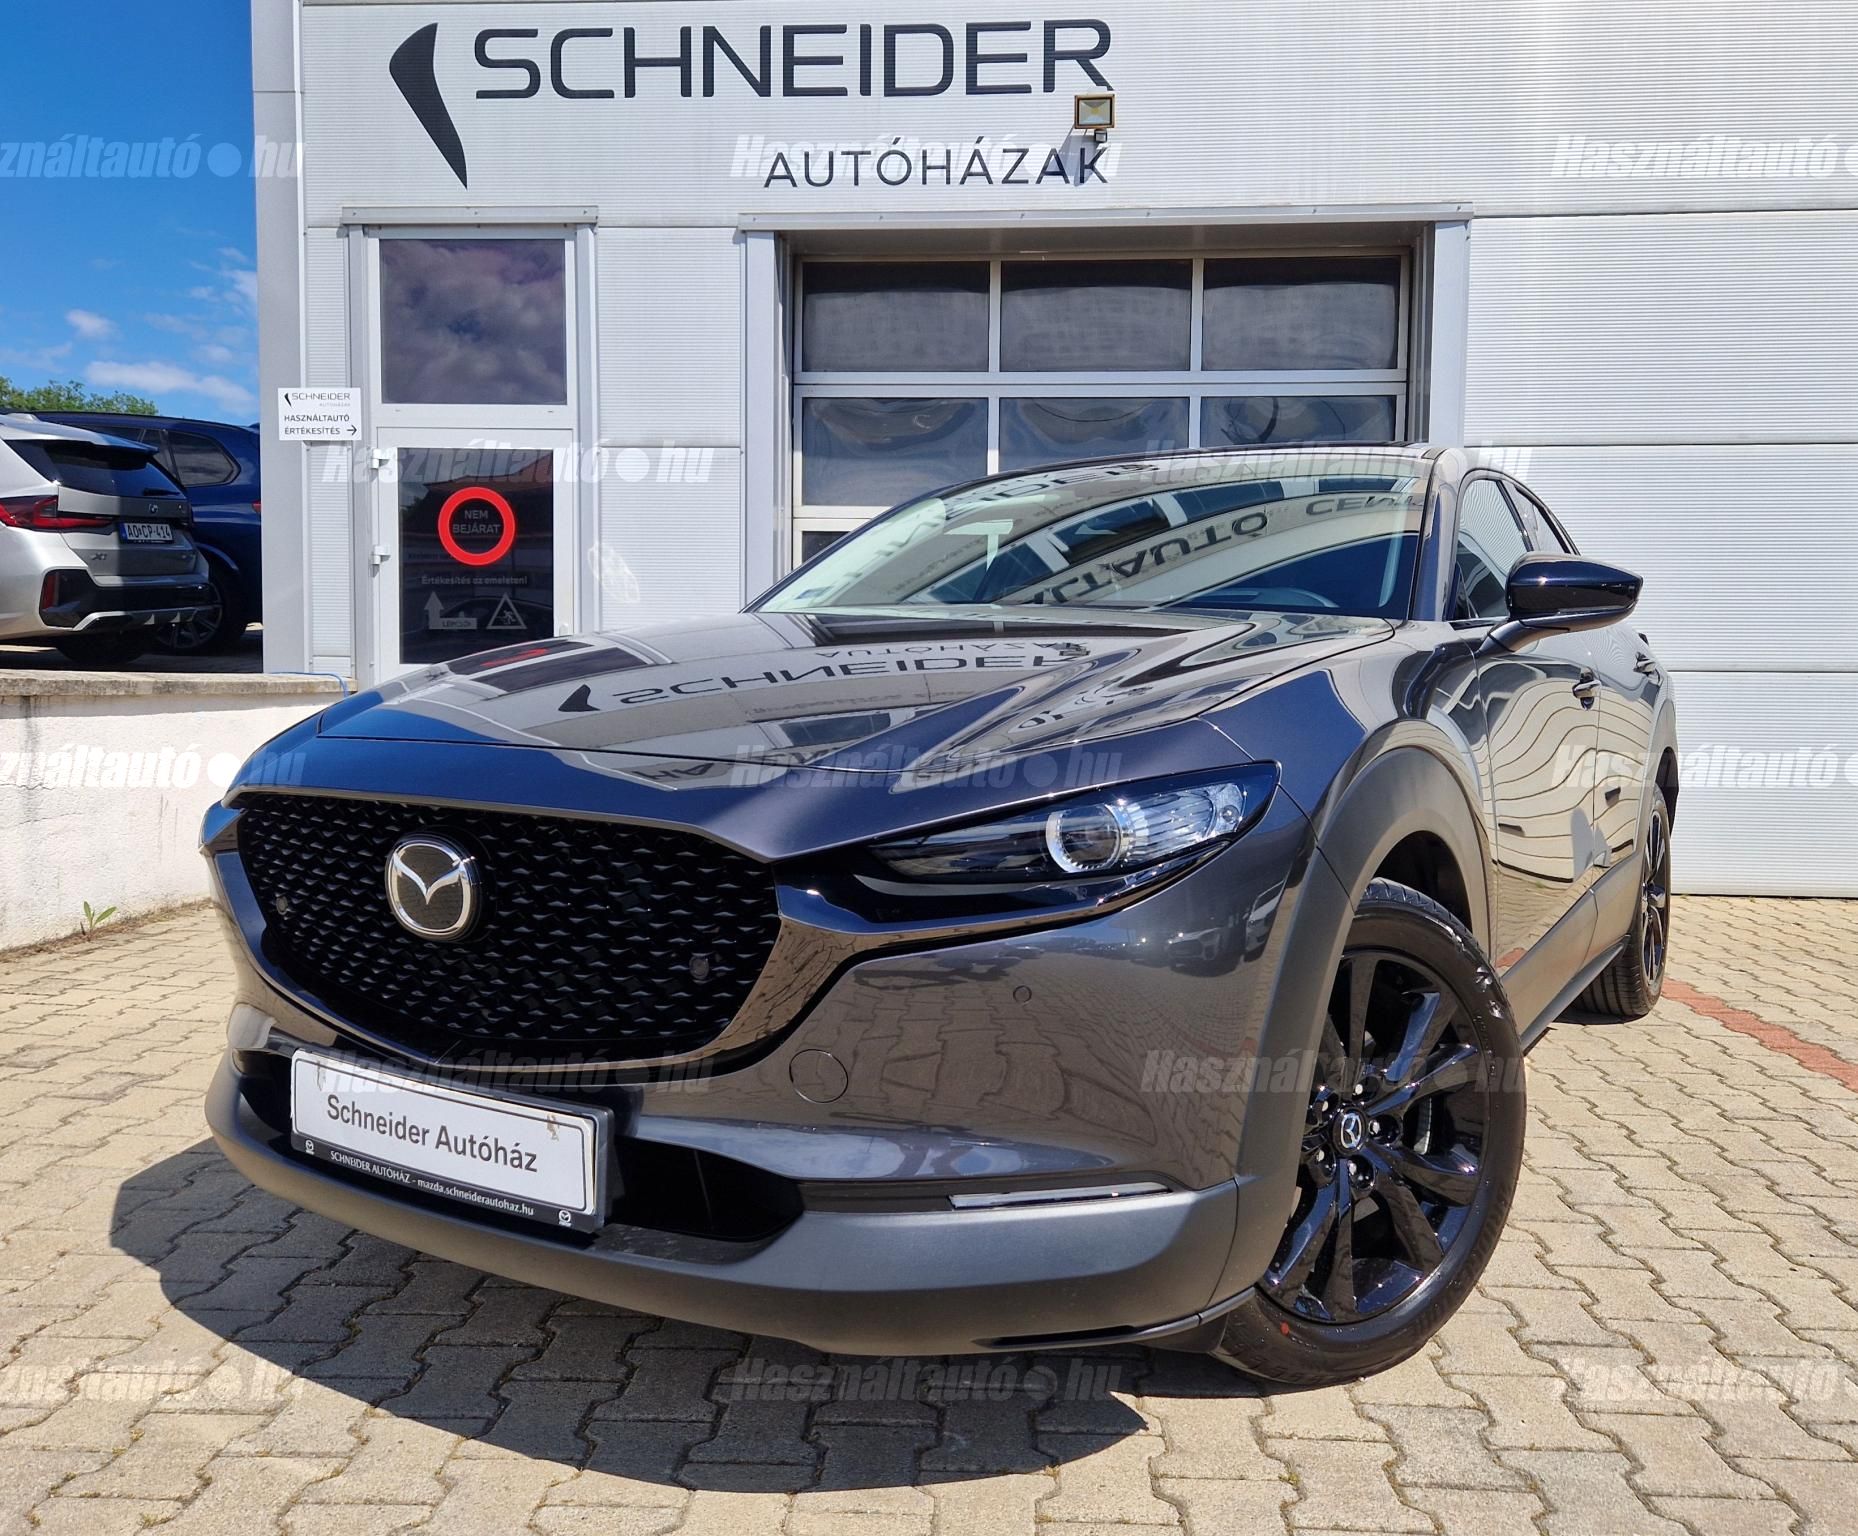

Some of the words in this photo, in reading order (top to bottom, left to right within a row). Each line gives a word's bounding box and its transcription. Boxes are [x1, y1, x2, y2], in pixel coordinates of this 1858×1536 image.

[475, 19, 1114, 99] SCHNEIDER
[764, 136, 1109, 188] AUTÓHÁZAK
[284, 414, 350, 422] HASZNÁLTAUTÓ
[284, 426, 341, 435] ÉRTÉKESÍTÉS
[452, 522, 501, 534] BEJÁRAT
[464, 510, 489, 519] NEM
[327, 1094, 430, 1146] Schneider
[435, 1125, 538, 1173] Autóház
[330, 1151, 371, 1173] SCHNEIDER
[372, 1164, 410, 1185] AUTÓHÁZ
[417, 1179, 534, 1217] mazda.schneiderautohaz.hu
